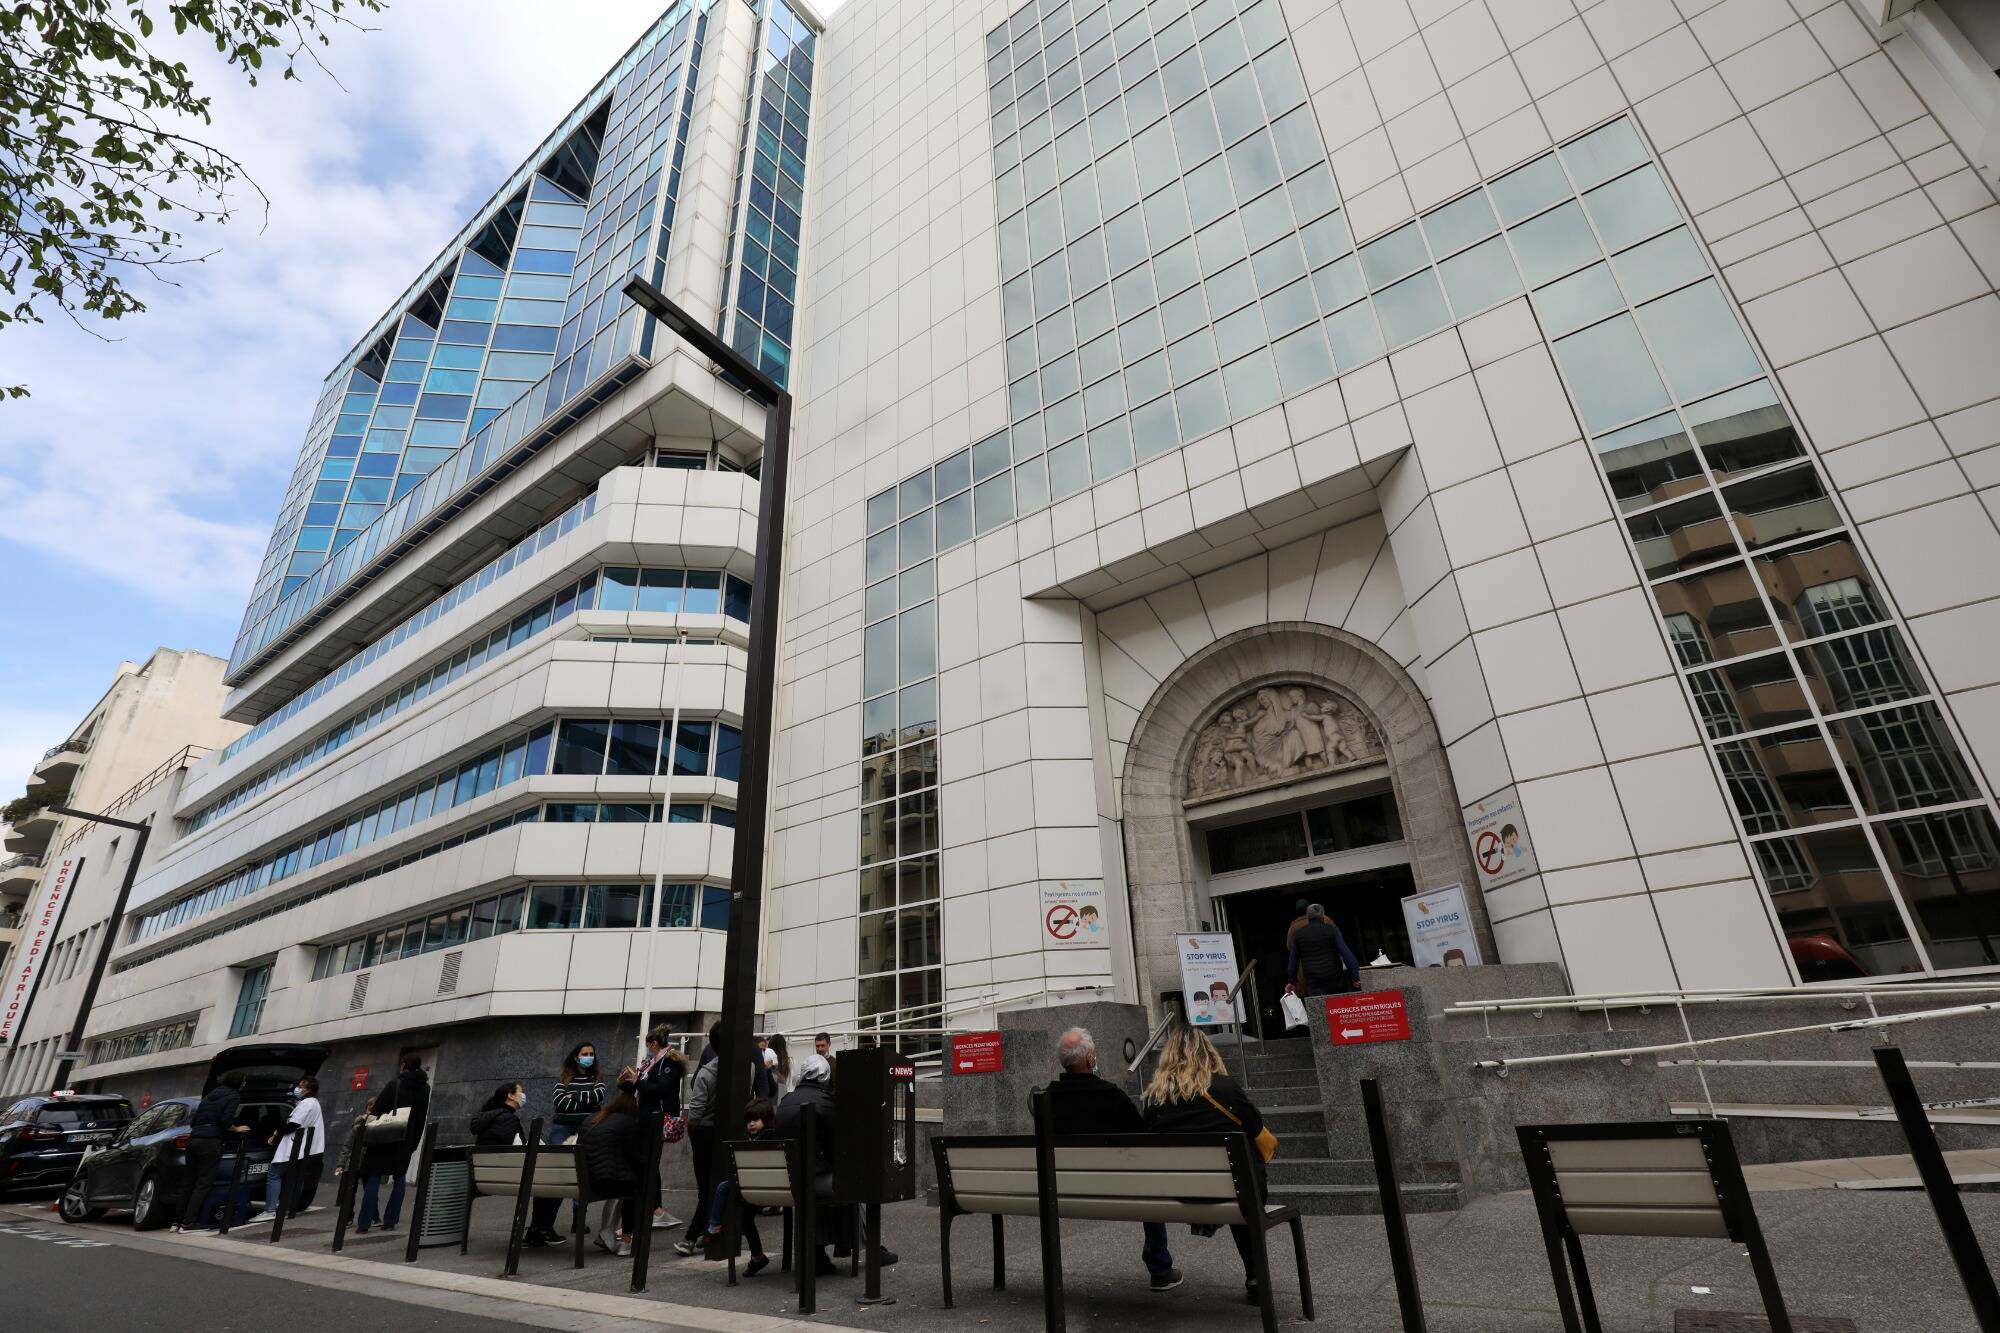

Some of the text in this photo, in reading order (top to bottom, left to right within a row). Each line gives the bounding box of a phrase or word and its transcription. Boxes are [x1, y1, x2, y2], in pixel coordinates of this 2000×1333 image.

[1416, 918, 1436, 929] STOP
[1436, 912, 1460, 924] VIRUS
[0, 859, 72, 1039] URGENCES PEDIATRIQUES
[1205, 952, 1227, 960] VIRUS
[1329, 1001, 1402, 1015] URGENCES PEDIATRIQUES
[895, 1067, 913, 1075] NEWS
